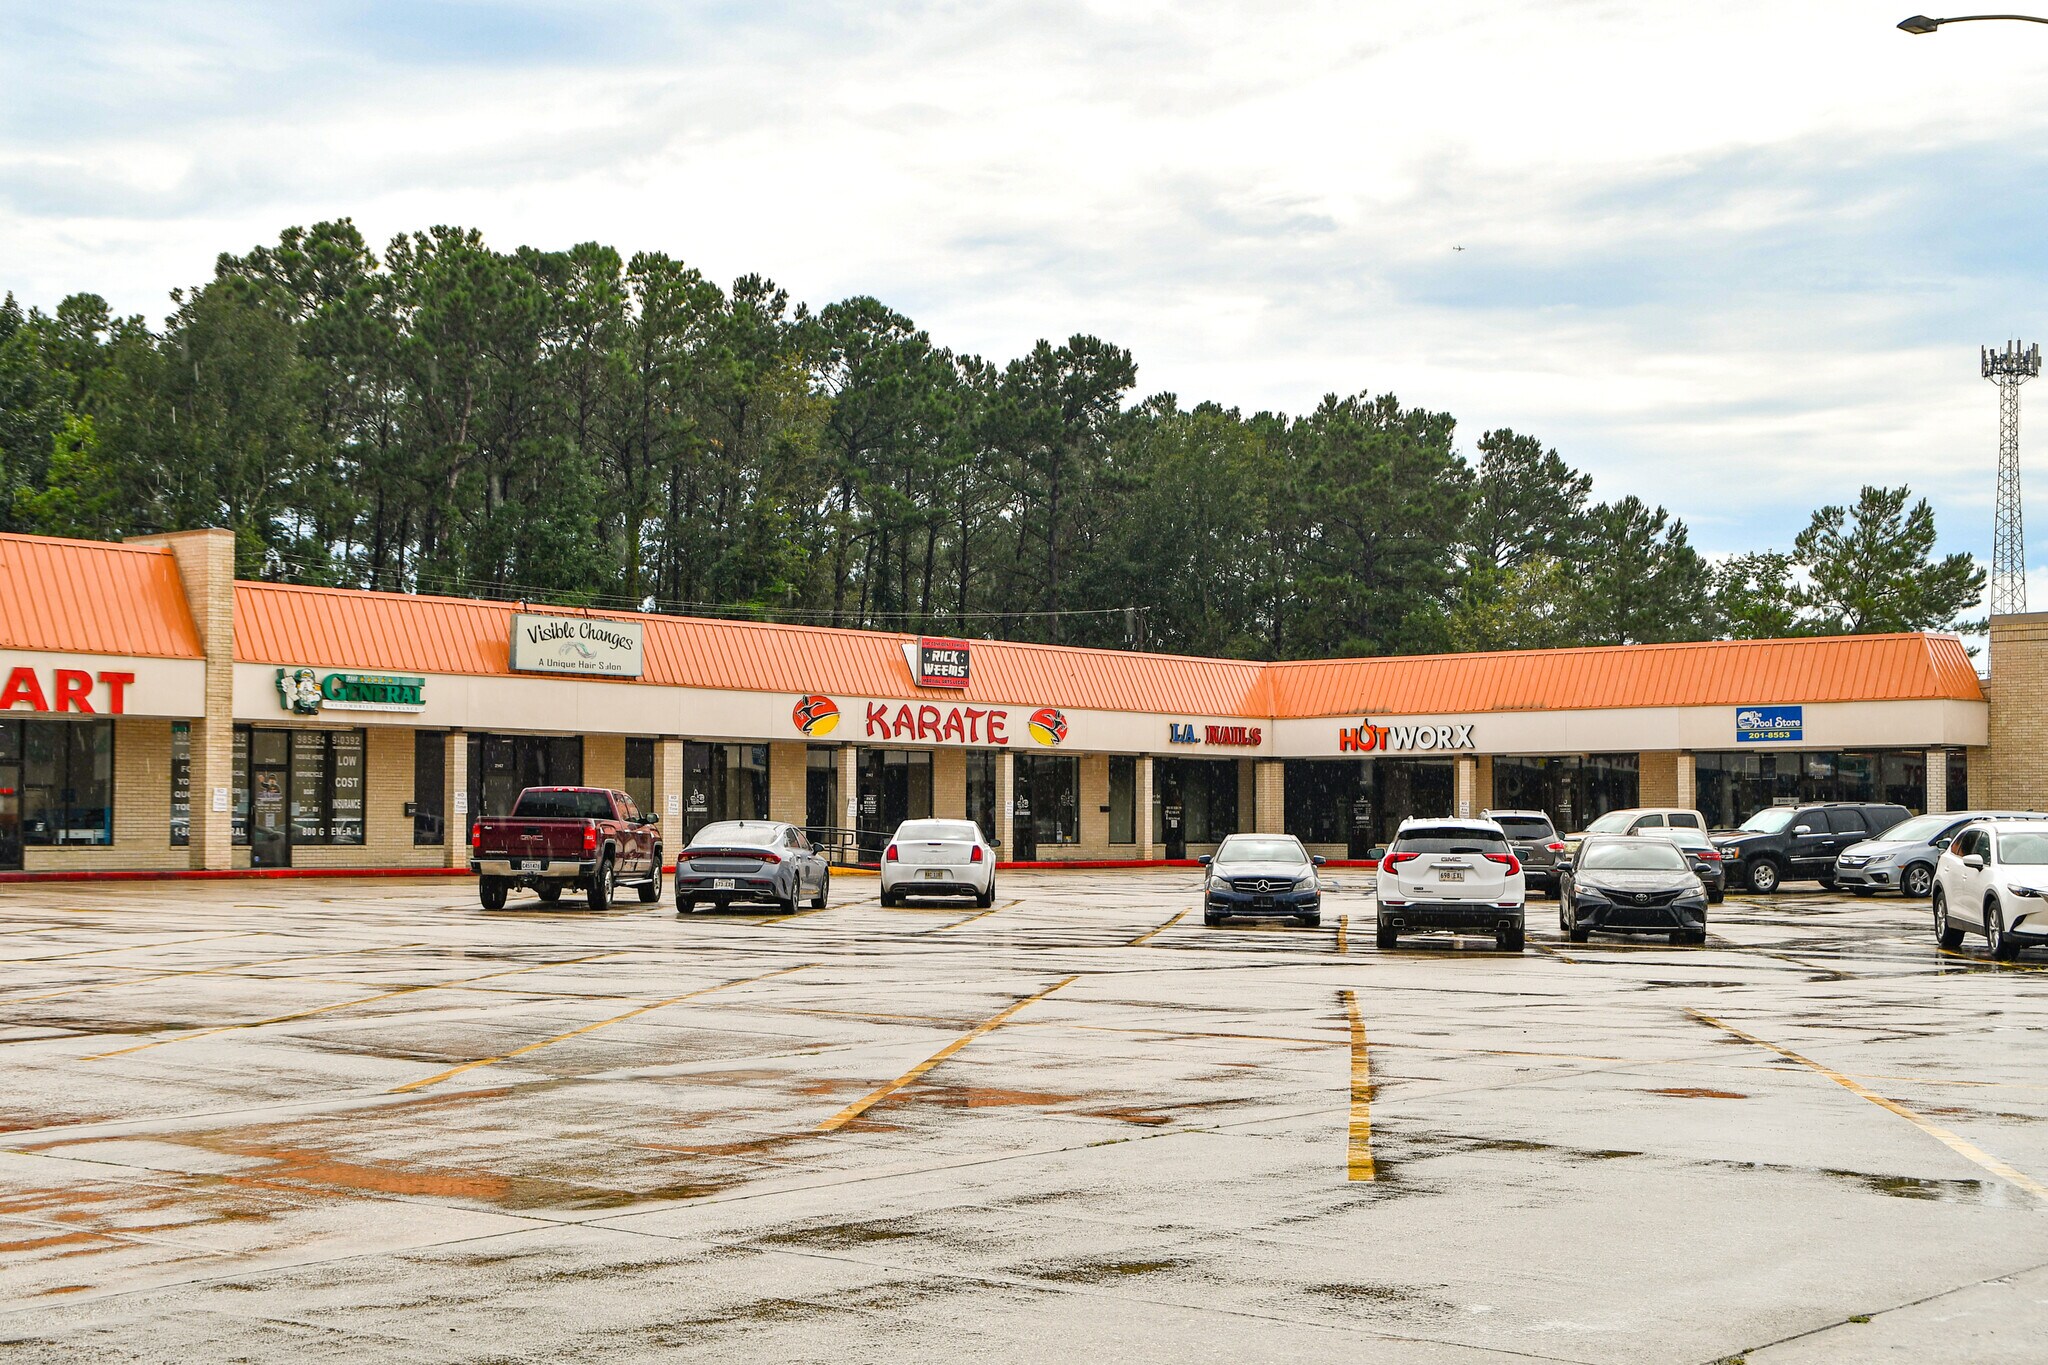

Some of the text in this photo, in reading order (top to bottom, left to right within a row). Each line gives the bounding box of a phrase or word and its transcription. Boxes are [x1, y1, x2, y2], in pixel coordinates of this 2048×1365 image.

[527, 621, 634, 650] Visible Changes
[538, 658, 622, 671] A Unique Hair Salon
[931, 650, 959, 664] RICK
[923, 662, 968, 677] WEEMS'
[0, 666, 135, 715] ART
[322, 673, 426, 705] GENERAL
[866, 701, 1009, 744] KARATE
[1753, 716, 1801, 729] Pool Store
[1205, 725, 1262, 746] NAILS
[1339, 718, 1475, 752] HOTWORX
[338, 756, 357, 766] LOW
[335, 777, 358, 788] COST
[332, 799, 361, 809] INSURANCE
